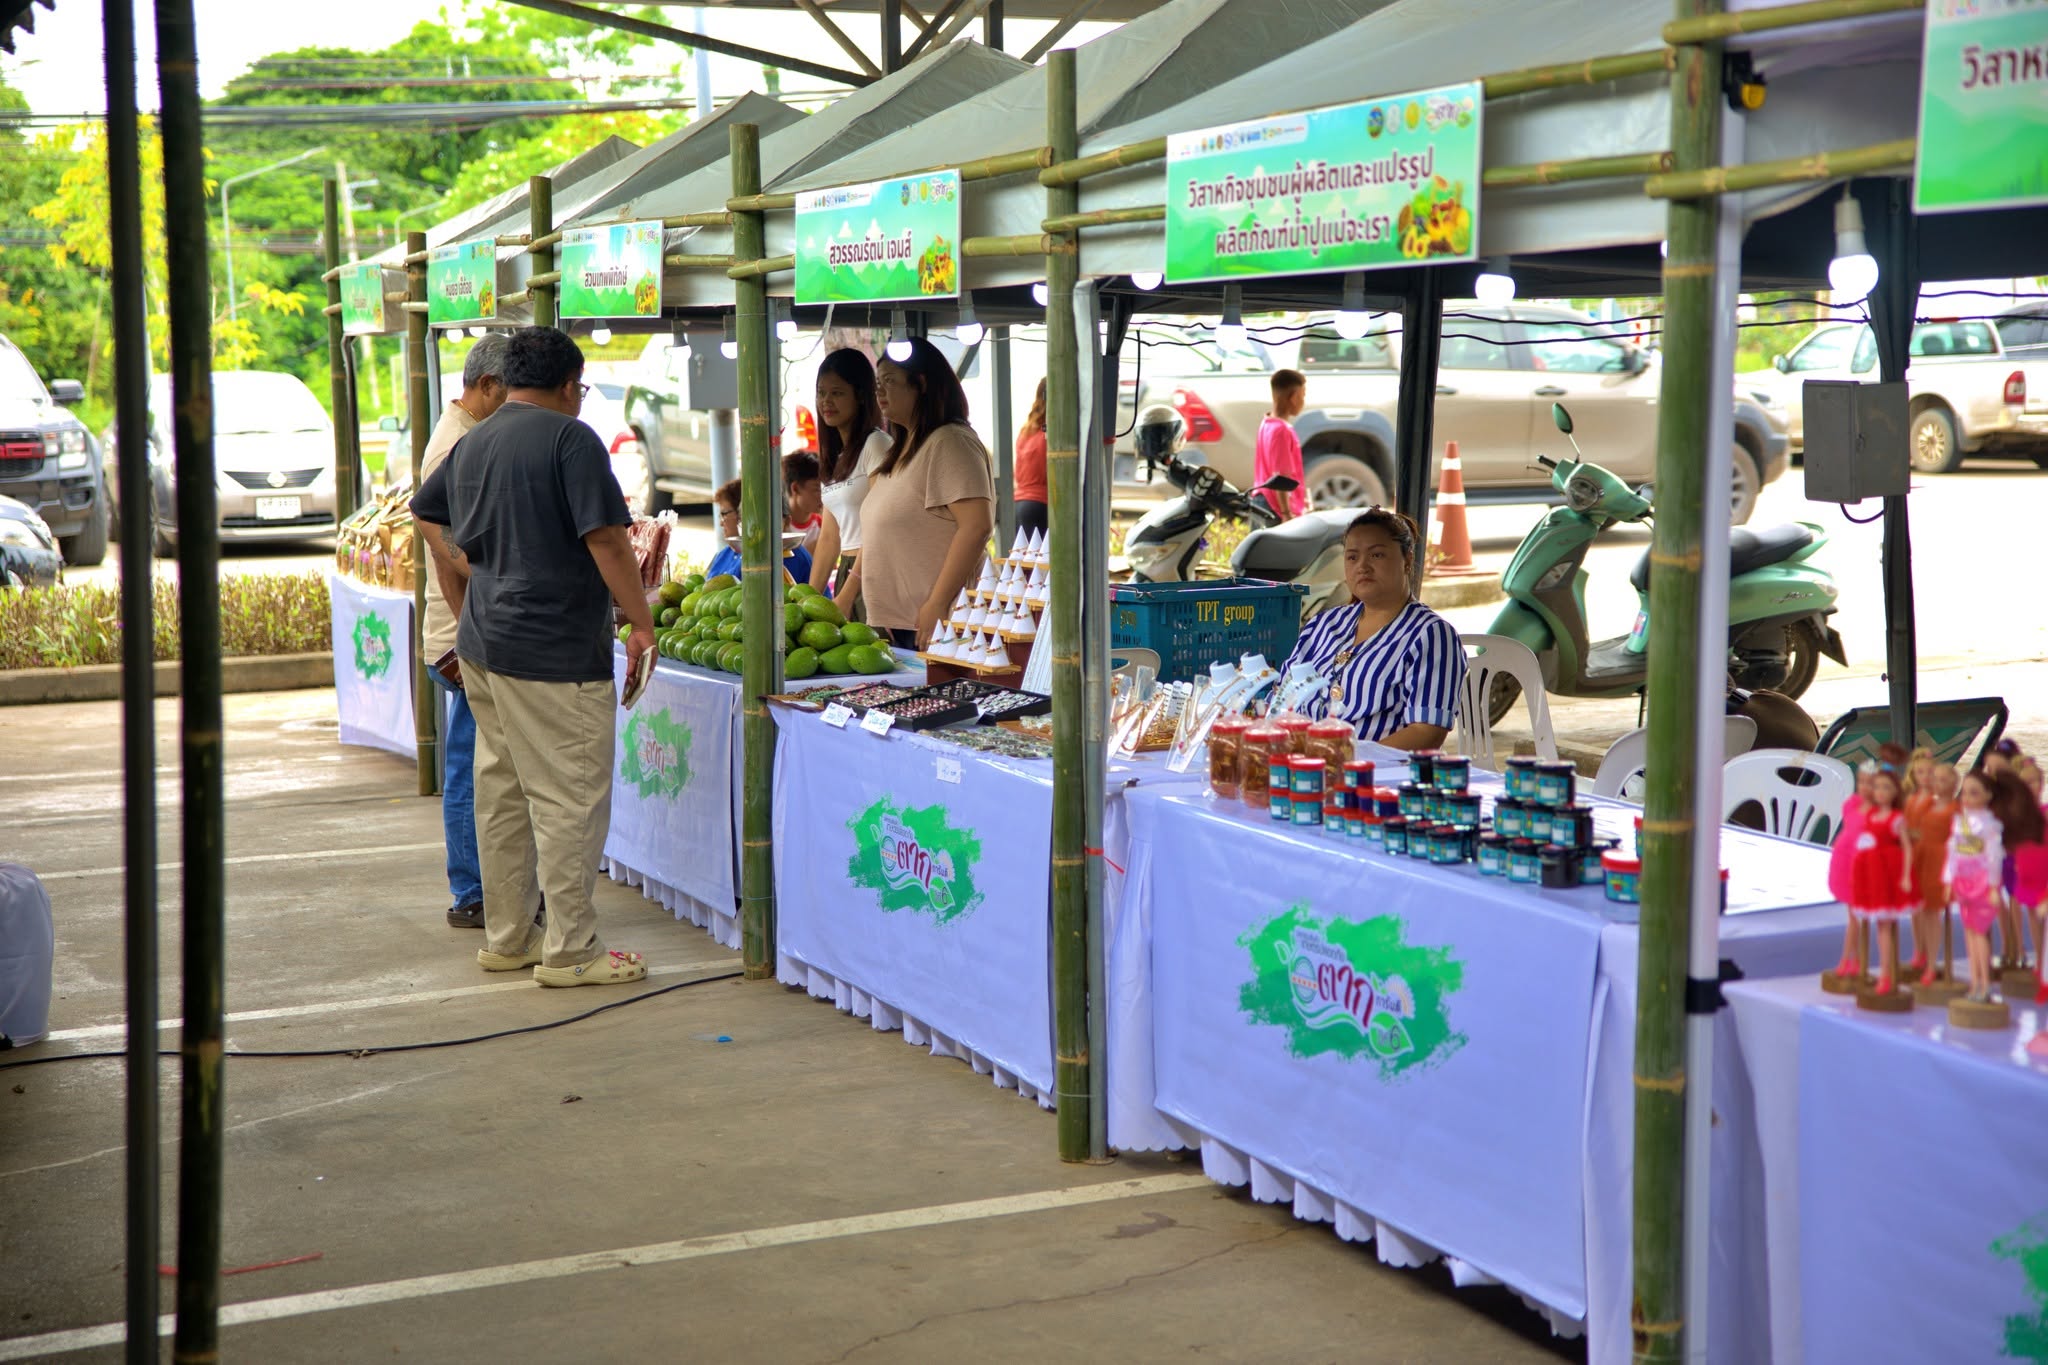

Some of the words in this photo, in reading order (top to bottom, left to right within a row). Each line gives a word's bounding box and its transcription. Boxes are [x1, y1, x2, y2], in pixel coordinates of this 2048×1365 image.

[1962, 44, 2048, 89] วิสาห
[1188, 146, 1434, 208] วิสาหกิจชุมชนผู้ผลิตและแปรรูป
[829, 234, 885, 272] สุวรรณรัตน์
[887, 231, 912, 260] เจมส์
[1215, 208, 1391, 256] ผลิตภัณฑ์น้ำปูแม่จะเรา
[1196, 601, 1220, 622] TPT
[1224, 604, 1255, 626] group
[897, 841, 932, 889] ตาก
[1318, 963, 1374, 1028] ตาก
